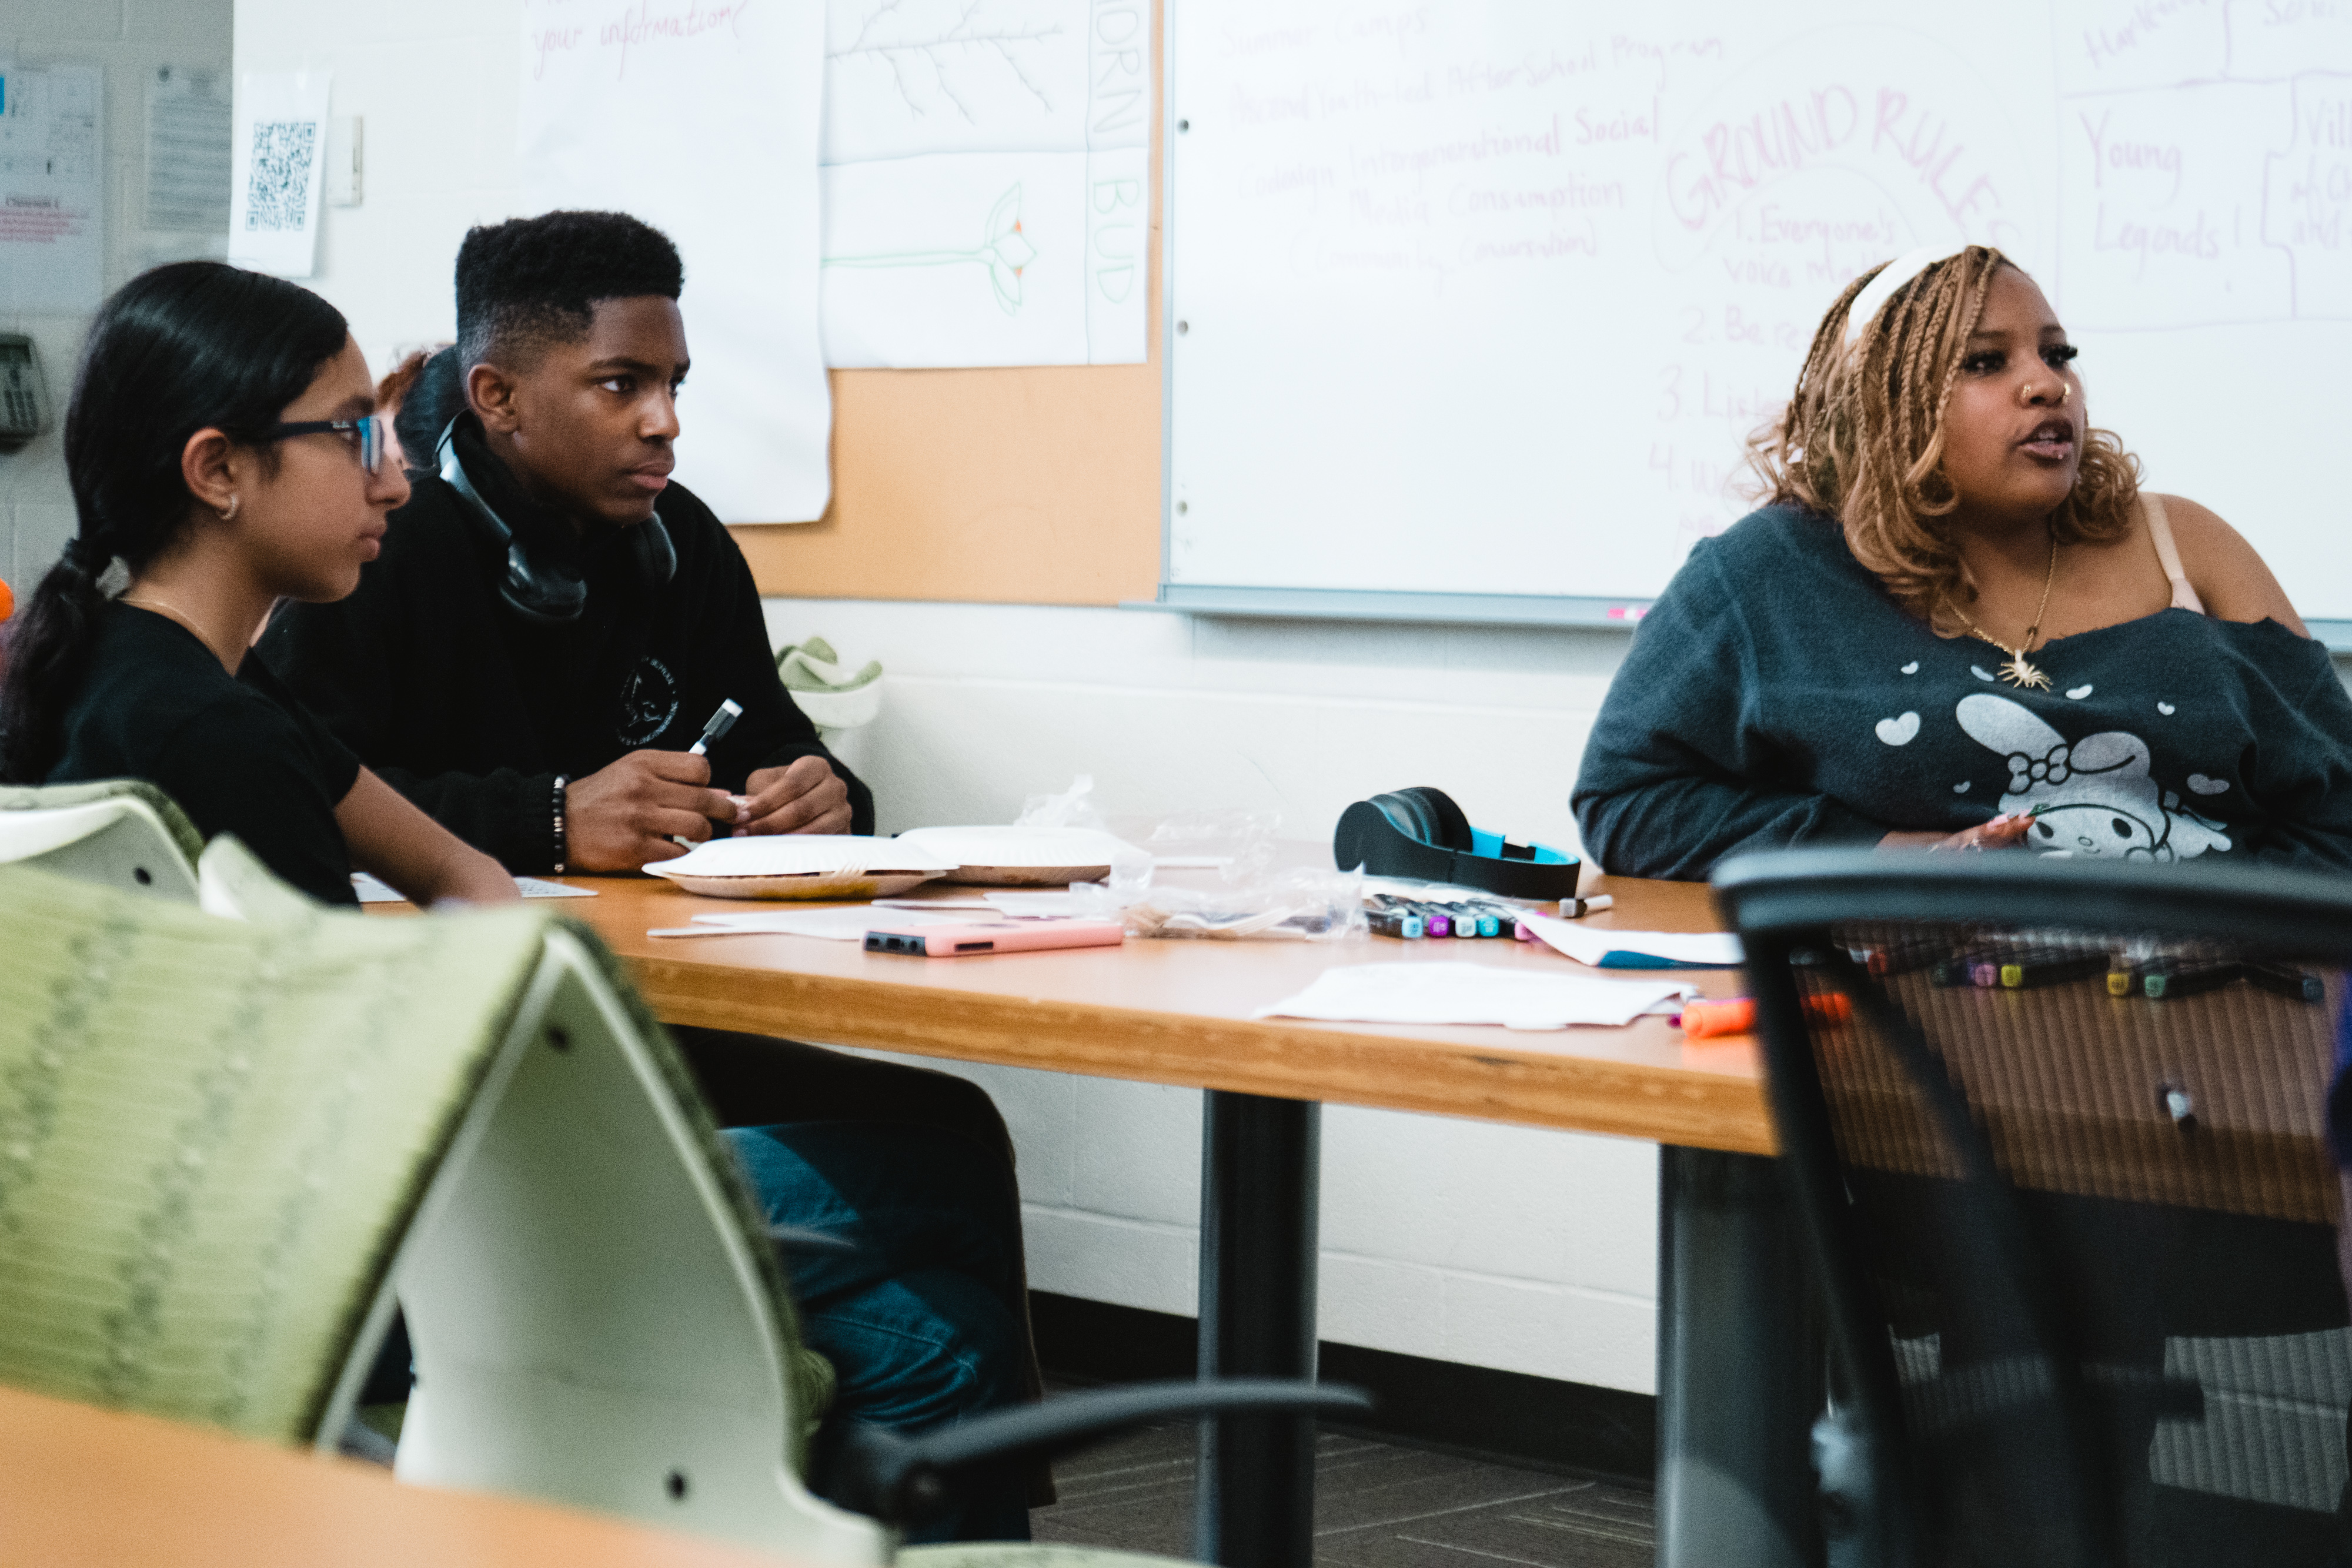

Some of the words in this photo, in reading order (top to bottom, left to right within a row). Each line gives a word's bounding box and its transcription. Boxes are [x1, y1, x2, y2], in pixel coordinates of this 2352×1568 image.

[531, 28, 583, 82] your
[1574, 95, 1659, 145] Social
[1666, 83, 1859, 232] GROUND
[2077, 107, 2183, 212] Young
[1093, 178, 1141, 304] BUD
